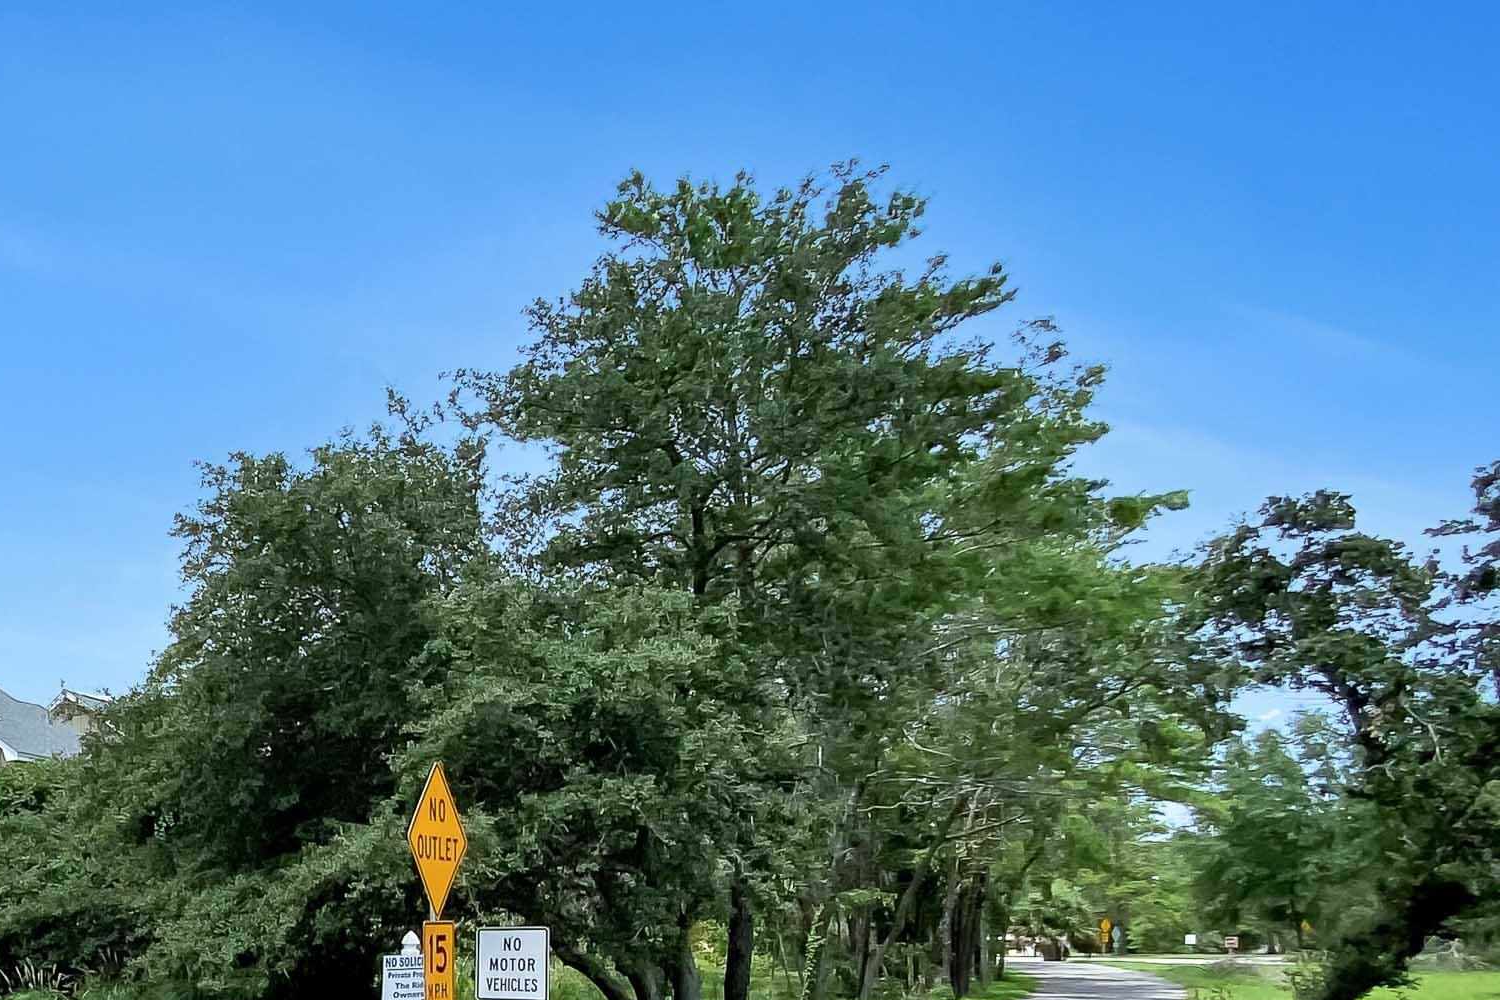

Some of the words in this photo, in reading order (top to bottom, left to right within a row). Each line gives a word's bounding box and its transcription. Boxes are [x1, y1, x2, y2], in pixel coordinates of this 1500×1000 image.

[429, 797, 446, 822] NO
[417, 834, 459, 862] OUTLET
[503, 938, 522, 951] NO
[429, 934, 447, 973] 15
[385, 957, 398, 968] NO
[489, 958, 536, 972] MOTOR
[428, 983, 448, 1000] MPH
[486, 978, 538, 993] VEHICLES
